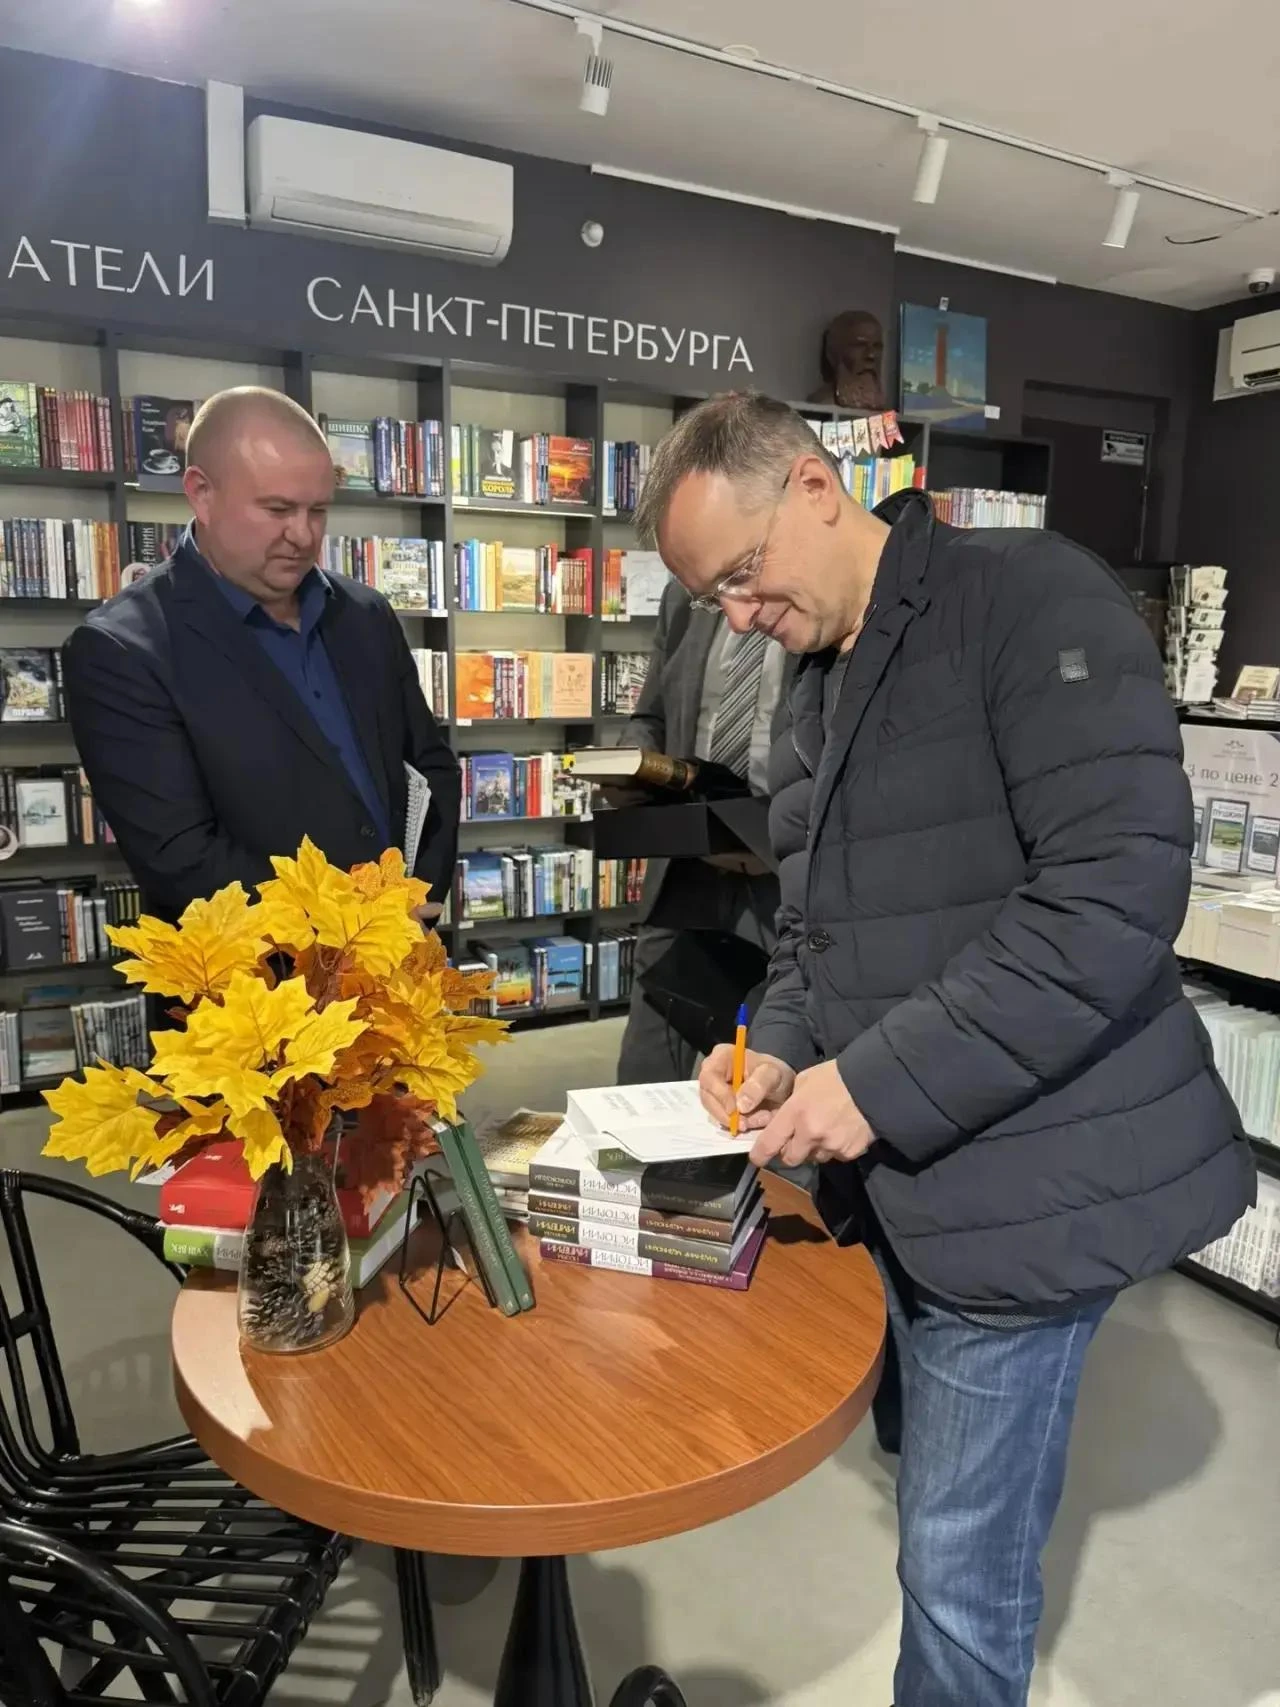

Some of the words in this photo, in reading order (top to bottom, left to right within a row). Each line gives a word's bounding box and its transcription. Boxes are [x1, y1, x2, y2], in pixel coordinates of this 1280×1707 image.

[8, 236, 214, 301] АТЕЛИ
[306, 277, 754, 373] САНКТ-ПЕТЕРБУРГА
[1200, 768, 1220, 781] по
[1225, 771, 1264, 786] цене
[1269, 772, 1279, 788] 2
[582, 1204, 636, 1220] ИСТОРИИ
[582, 1227, 636, 1243] ИСТОРИИ
